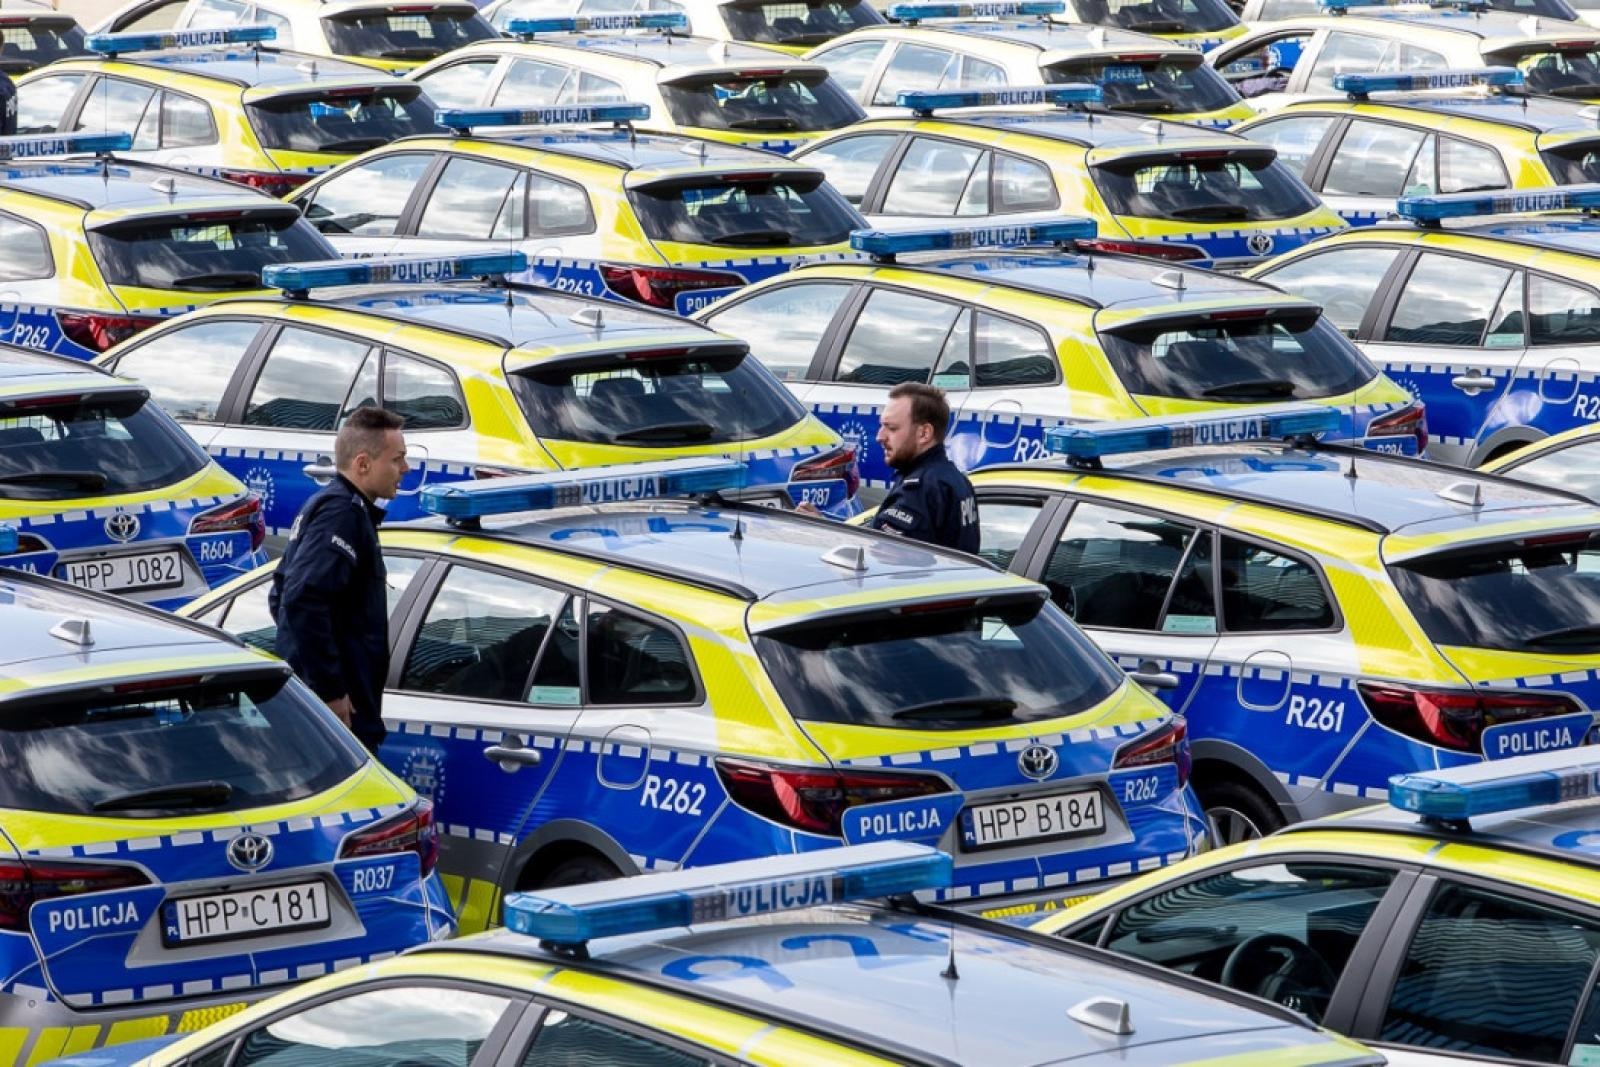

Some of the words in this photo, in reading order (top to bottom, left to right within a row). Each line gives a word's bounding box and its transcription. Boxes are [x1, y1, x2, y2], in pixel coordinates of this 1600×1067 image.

[201, 540, 232, 561] R604
[72, 564, 113, 588] HPP
[127, 556, 176, 584] J082
[1286, 695, 1345, 732] R261
[1499, 727, 1572, 754] POLICJA
[640, 774, 706, 816] R262
[1125, 776, 1158, 803] R262
[860, 808, 941, 837] POLICJA
[979, 806, 1026, 841] HPP
[1036, 796, 1097, 832] B184
[49, 902, 139, 933] POLICJA
[184, 899, 238, 935] HPP
[252, 887, 318, 926] C181
